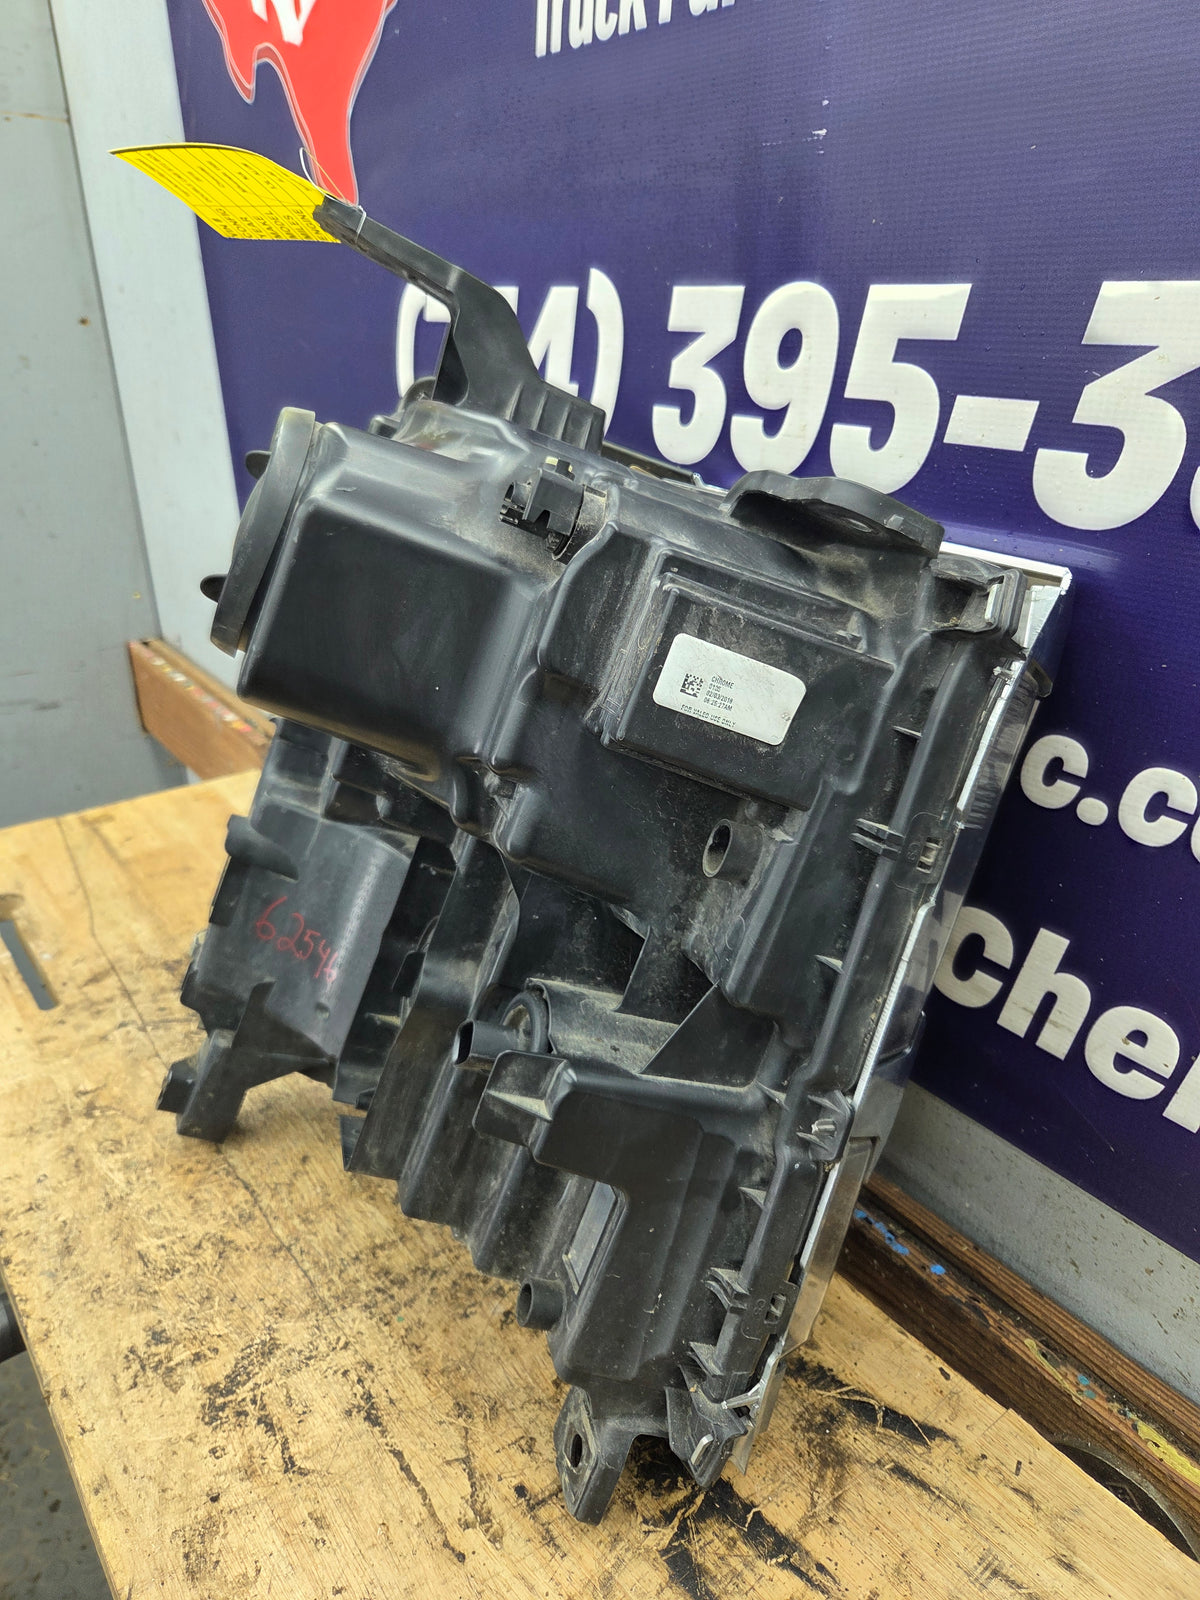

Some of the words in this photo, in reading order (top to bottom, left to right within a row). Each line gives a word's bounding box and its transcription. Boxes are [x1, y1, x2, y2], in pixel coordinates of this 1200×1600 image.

[240, 216, 266, 238] YEAR
[265, 210, 296, 239] MODEL
[292, 208, 328, 241] ENGINE
[651, 276, 1200, 531] 395-3
[1020, 734, 1200, 863] c.c
[256, 895, 339, 984] 62546
